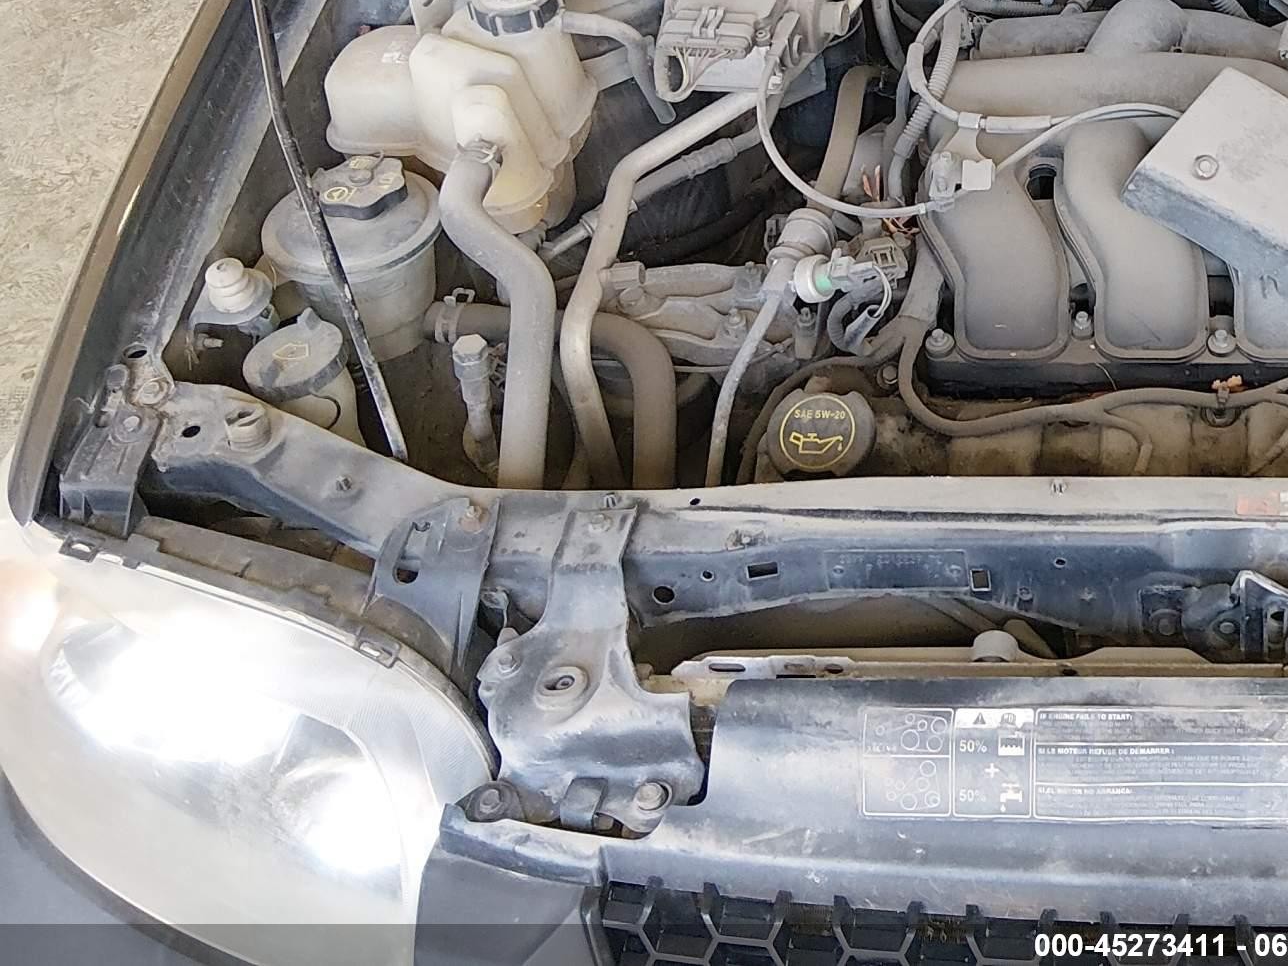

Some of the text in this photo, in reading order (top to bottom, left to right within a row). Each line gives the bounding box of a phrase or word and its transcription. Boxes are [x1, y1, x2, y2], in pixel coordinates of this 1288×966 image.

[794, 409, 846, 420] SAE 5W-20
[959, 740, 988, 753] 50%
[959, 789, 986, 802] 50%
